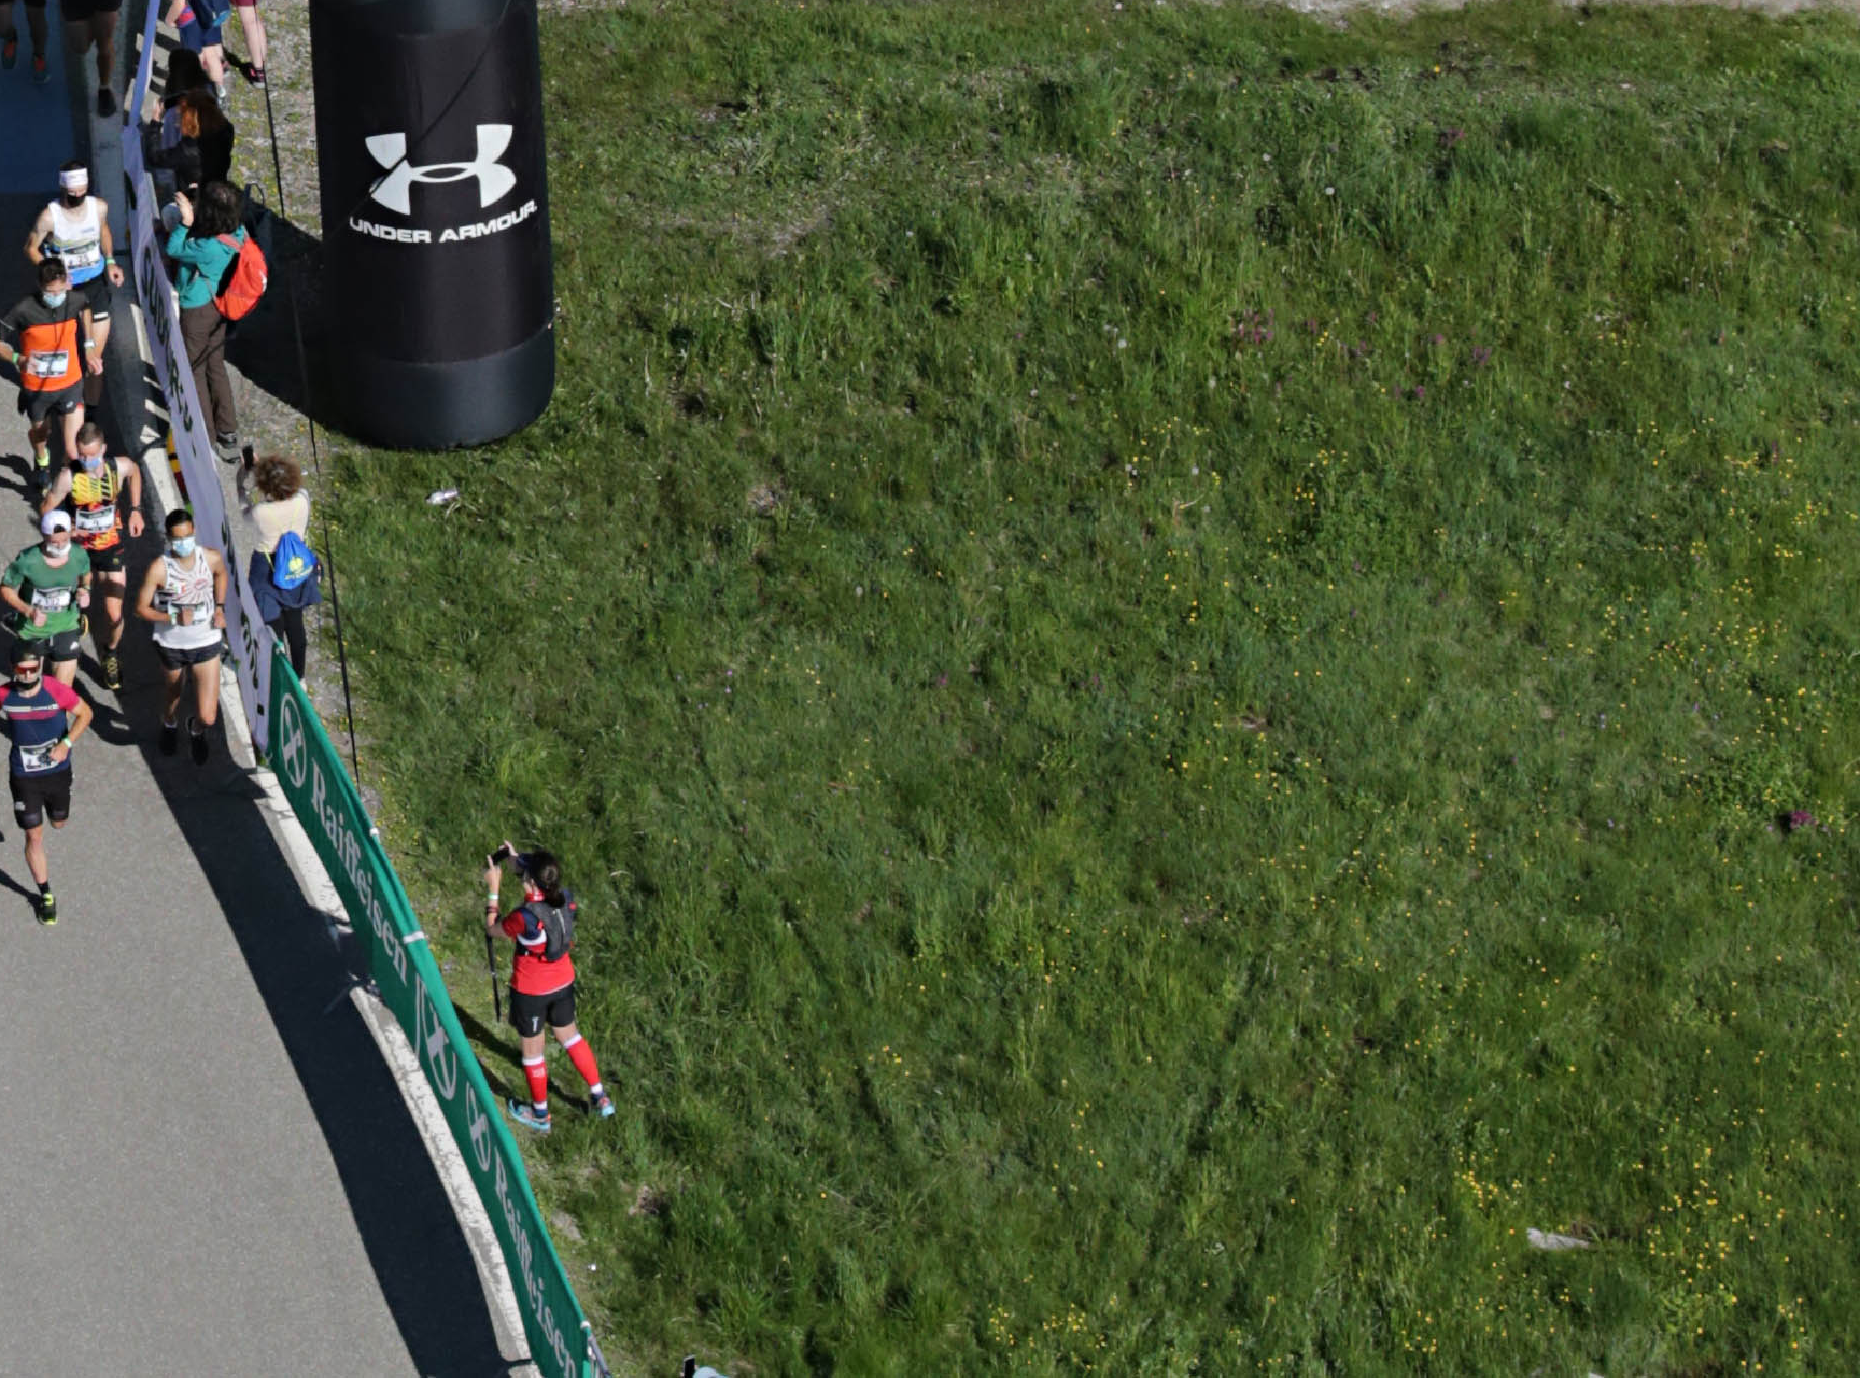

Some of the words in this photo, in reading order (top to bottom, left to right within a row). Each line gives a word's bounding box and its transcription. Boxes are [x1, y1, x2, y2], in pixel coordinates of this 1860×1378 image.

[349, 215, 432, 244] UNDER
[439, 198, 538, 243] ARMOUR
[309, 755, 408, 987] Raiffeisen
[493, 1154, 580, 1377] Raiffeisen
